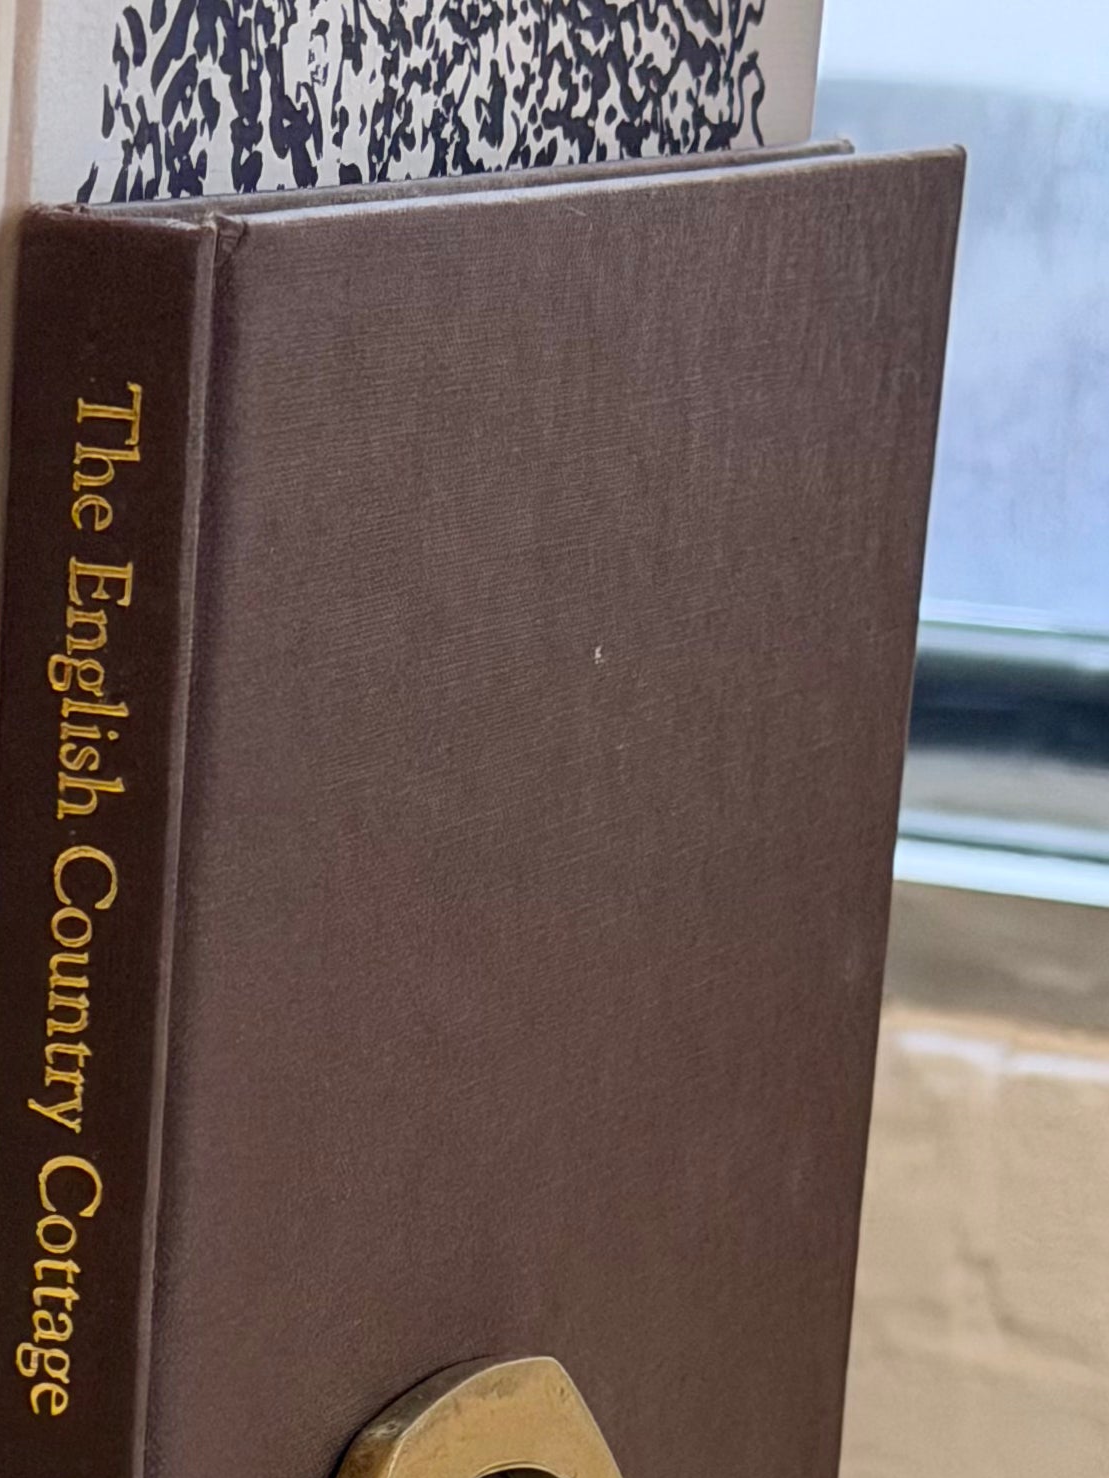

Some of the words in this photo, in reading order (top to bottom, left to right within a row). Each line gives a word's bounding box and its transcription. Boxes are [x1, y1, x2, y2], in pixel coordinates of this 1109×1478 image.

[71, 383, 142, 531] The
[48, 557, 133, 819] English
[28, 846, 117, 1133] Country
[16, 1156, 102, 1415] Cottage
